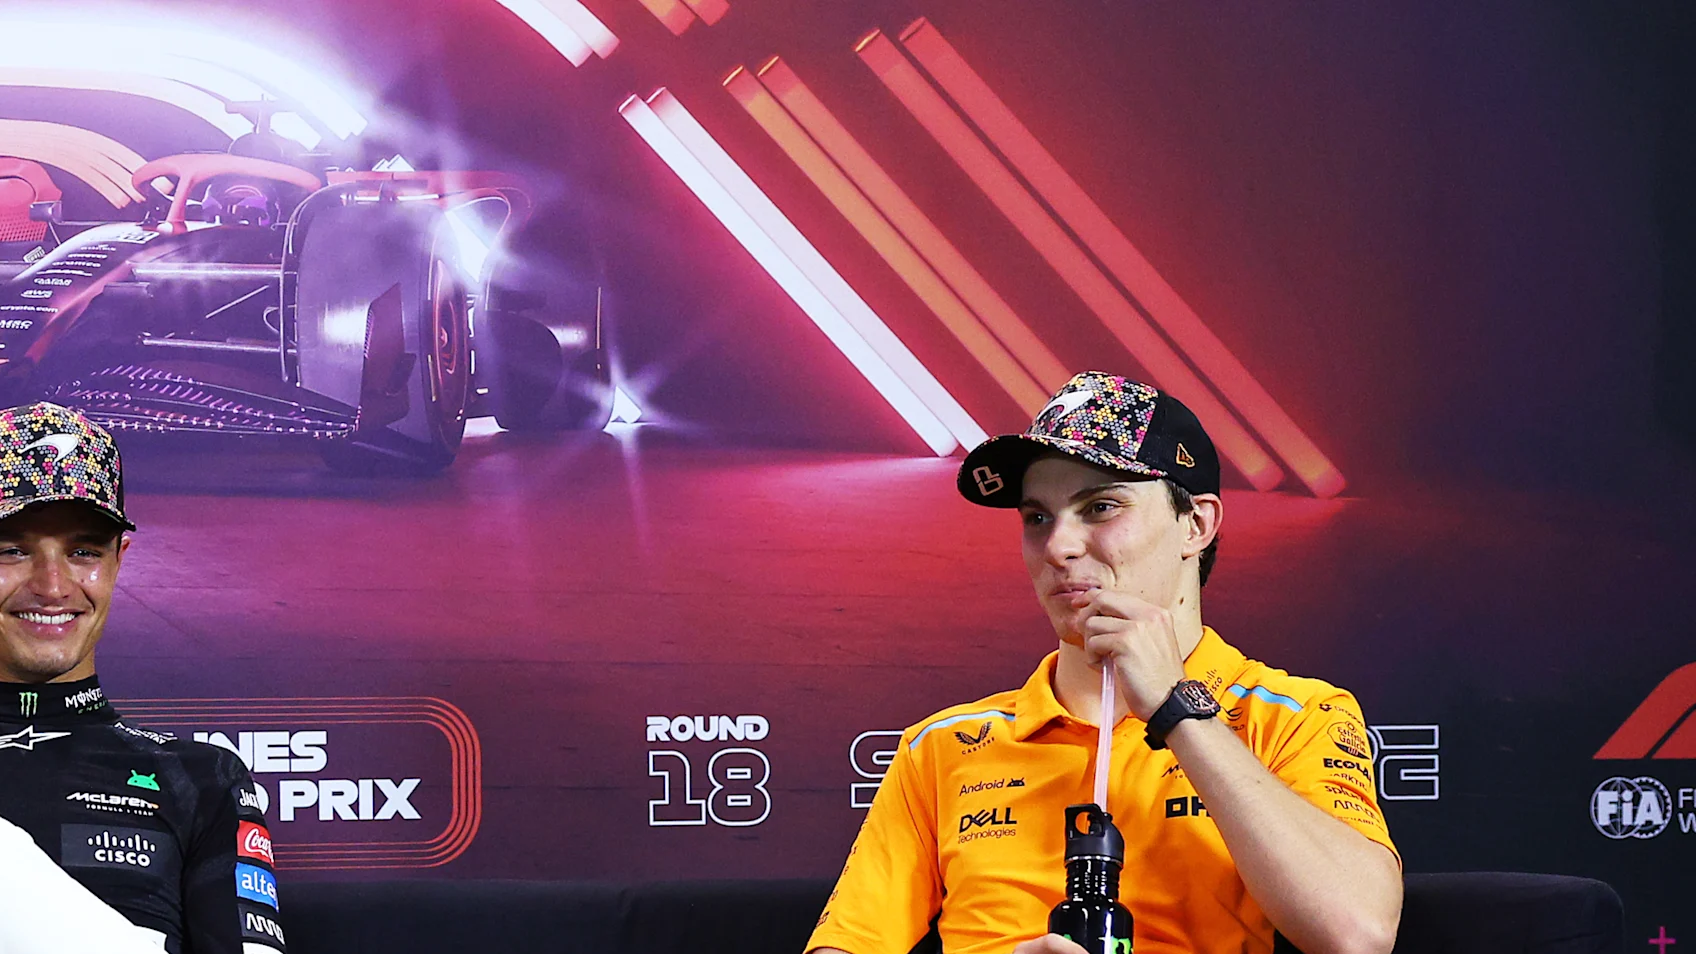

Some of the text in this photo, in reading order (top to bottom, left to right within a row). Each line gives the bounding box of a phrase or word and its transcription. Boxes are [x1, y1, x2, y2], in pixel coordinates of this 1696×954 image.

[646, 714, 770, 742] ROUND
[193, 730, 329, 773] NES
[961, 736, 995, 755] CASTORE
[1323, 757, 1372, 788] ECOLA
[1366, 725, 1440, 800] E
[279, 778, 422, 821] PRIX
[648, 747, 772, 826] 18
[959, 779, 1005, 797] Android
[66, 792, 154, 809] McLaren
[86, 804, 124, 813] FORMULA
[959, 807, 1017, 833] DELL
[957, 828, 1017, 844] Technologies
